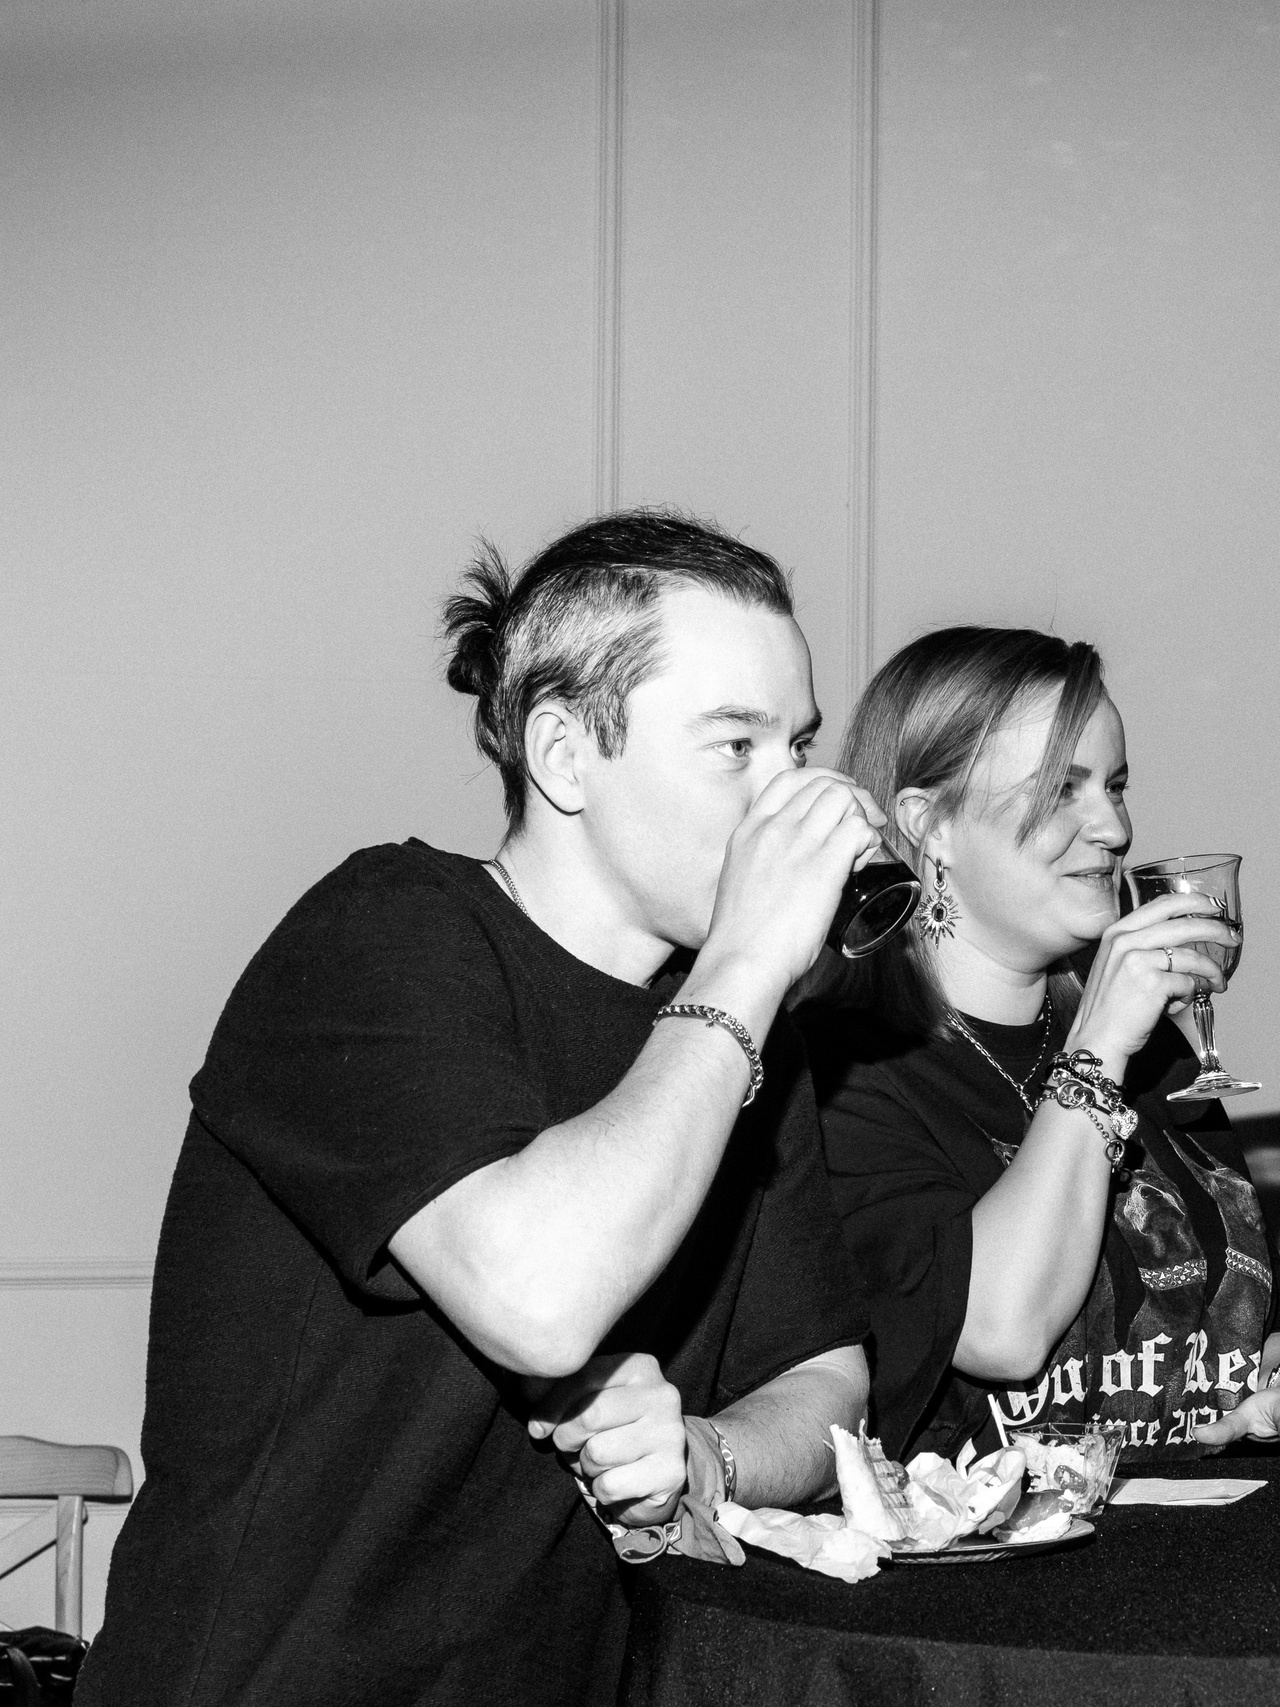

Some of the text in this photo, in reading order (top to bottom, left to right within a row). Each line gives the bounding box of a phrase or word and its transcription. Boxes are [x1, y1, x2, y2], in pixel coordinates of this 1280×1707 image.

[991, 1329, 1261, 1426] Ou of Rea
[1086, 1405, 1234, 1447] ince 202
